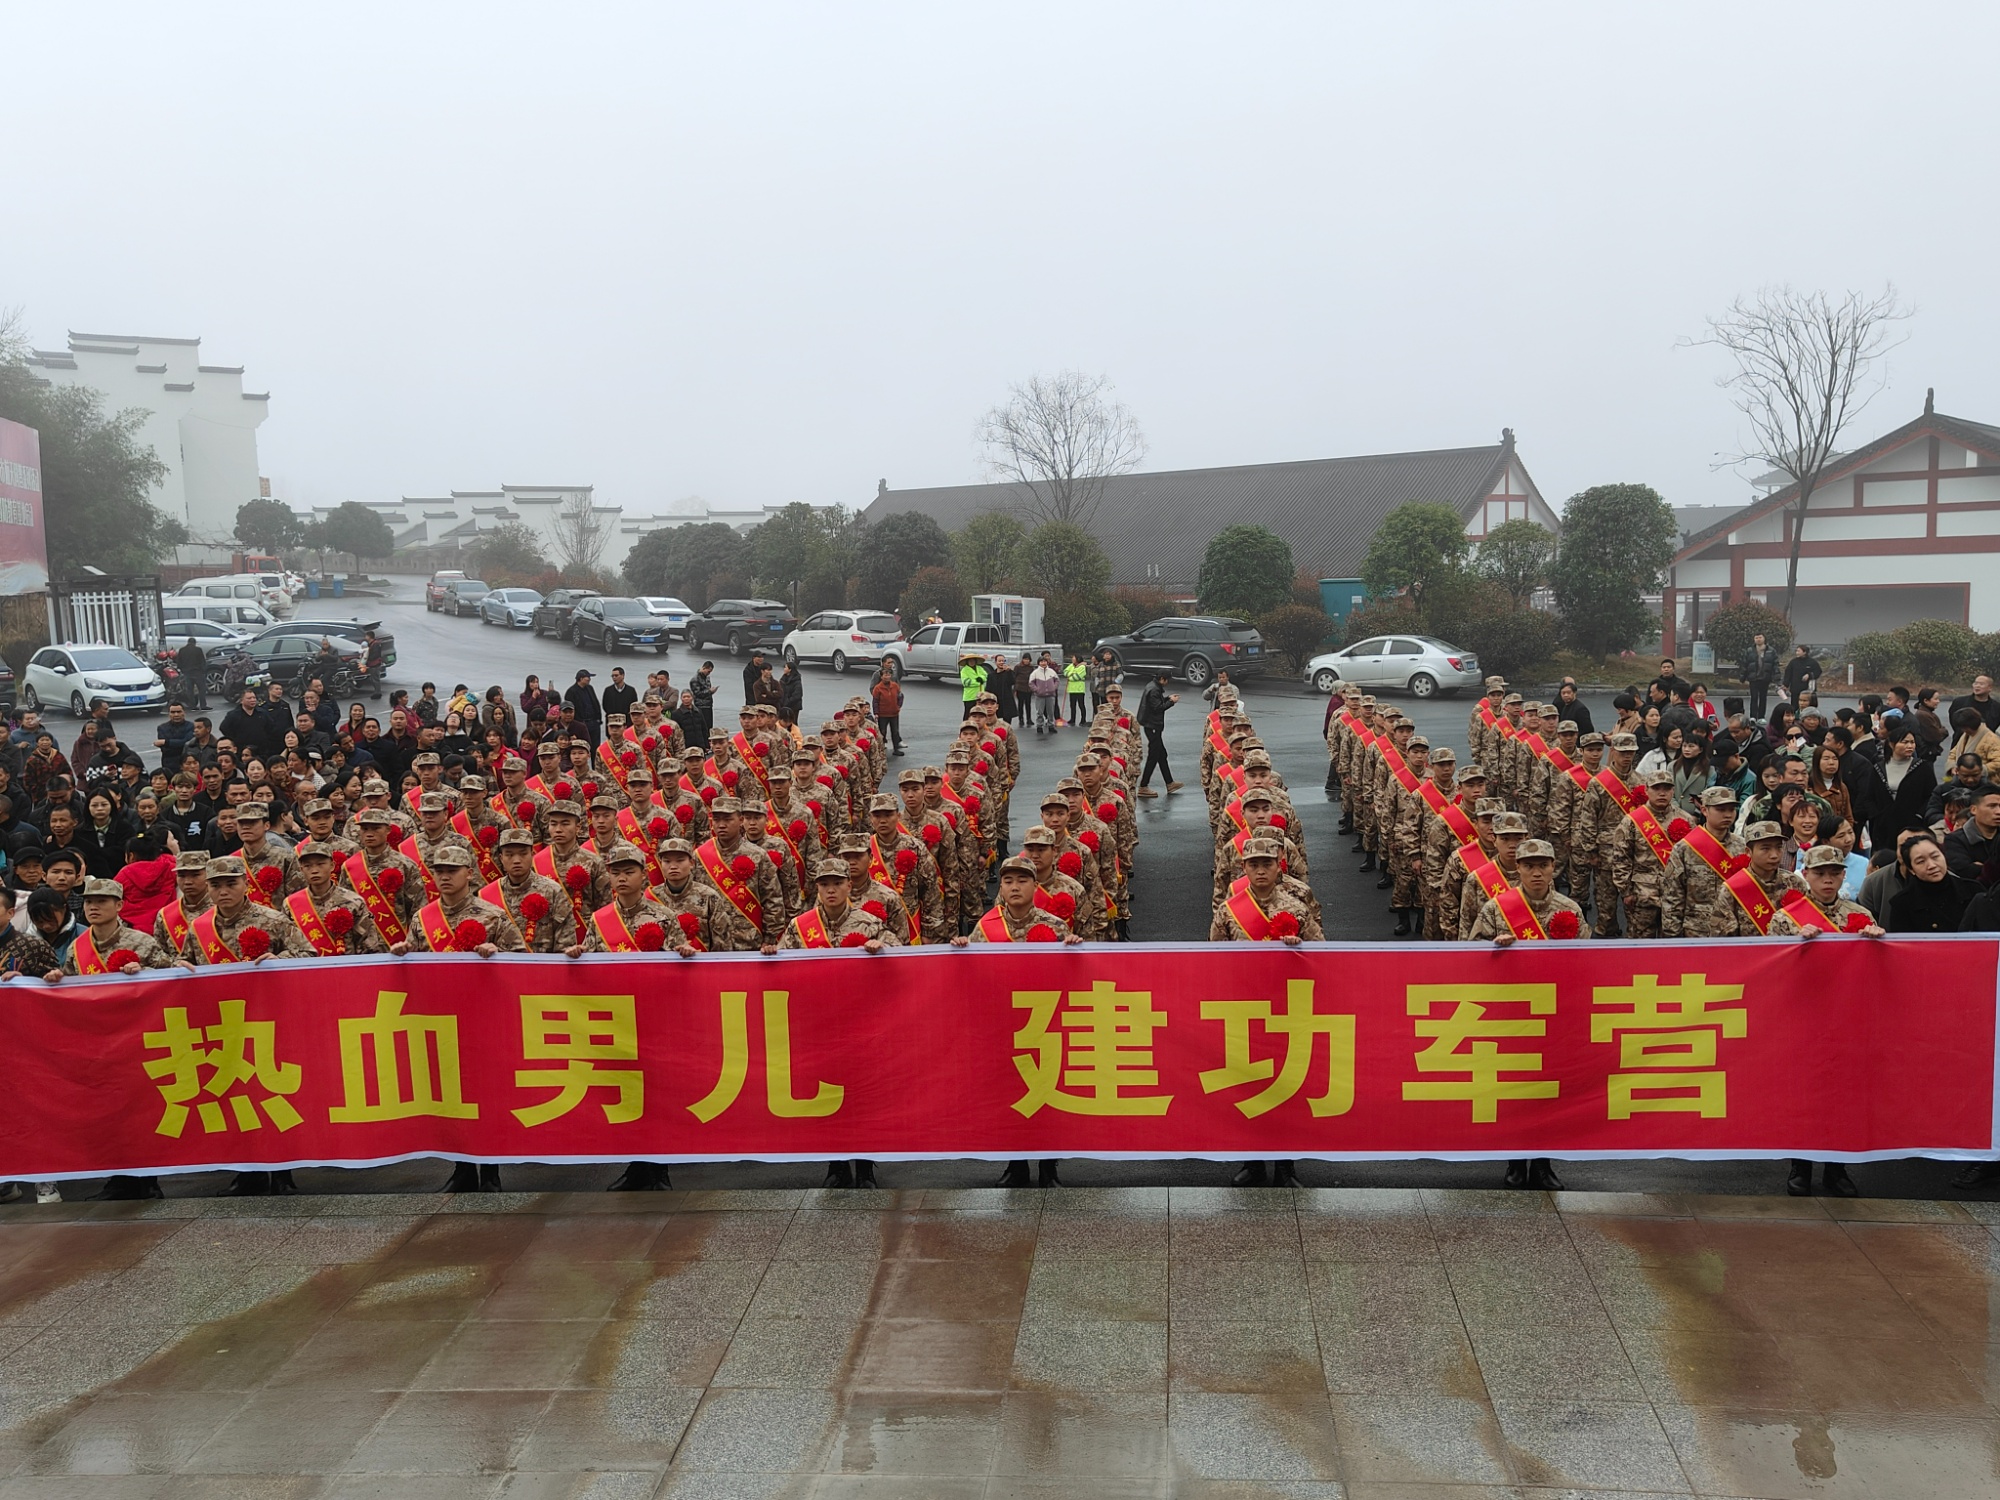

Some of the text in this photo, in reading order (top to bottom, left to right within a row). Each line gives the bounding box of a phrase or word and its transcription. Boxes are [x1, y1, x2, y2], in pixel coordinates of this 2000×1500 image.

[358, 879, 400, 937] 光荣入伍
[141, 972, 1749, 1138] 热血男儿 建功军营
